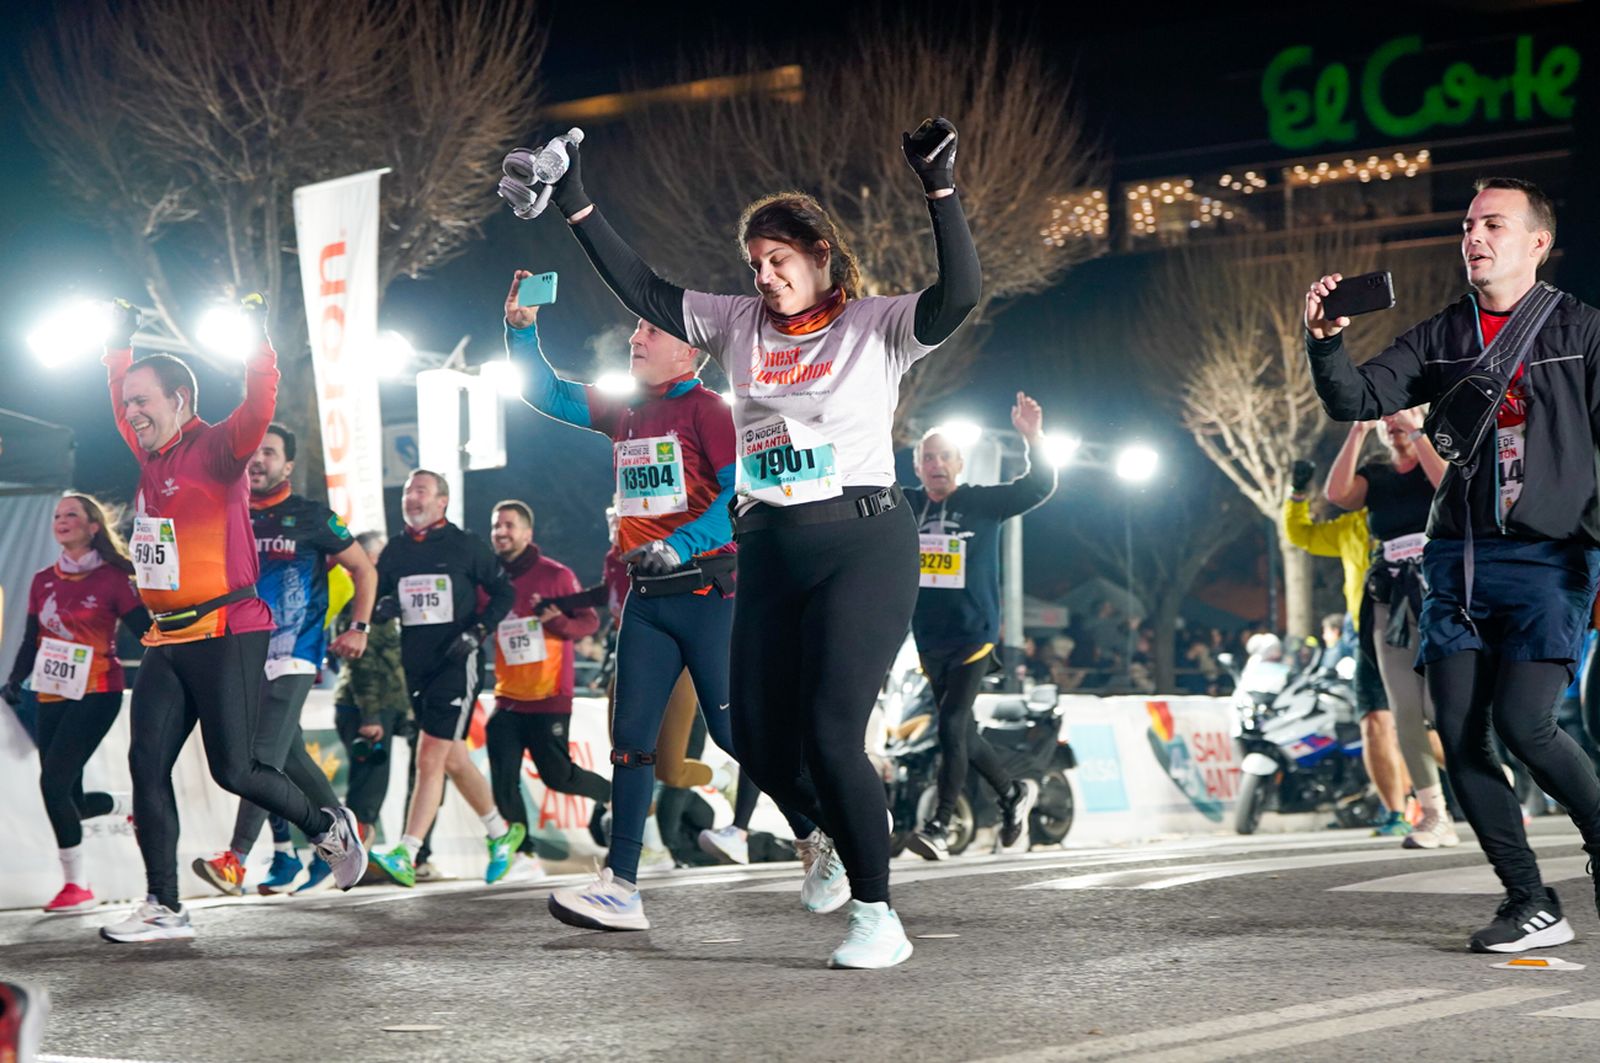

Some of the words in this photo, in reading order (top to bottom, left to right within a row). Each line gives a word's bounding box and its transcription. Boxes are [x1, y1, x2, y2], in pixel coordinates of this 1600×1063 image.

[1262, 45, 1356, 148] El
[1361, 35, 1581, 136] Corte
[755, 425, 781, 440] NOCHE
[746, 441, 763, 455] SAN
[756, 448, 815, 480] 7901
[622, 464, 675, 490] 13504
[135, 543, 165, 565] 5915
[411, 592, 440, 608] 7015
[509, 634, 530, 649] 675
[44, 658, 76, 680] 6201
[1191, 731, 1232, 763] SAN
